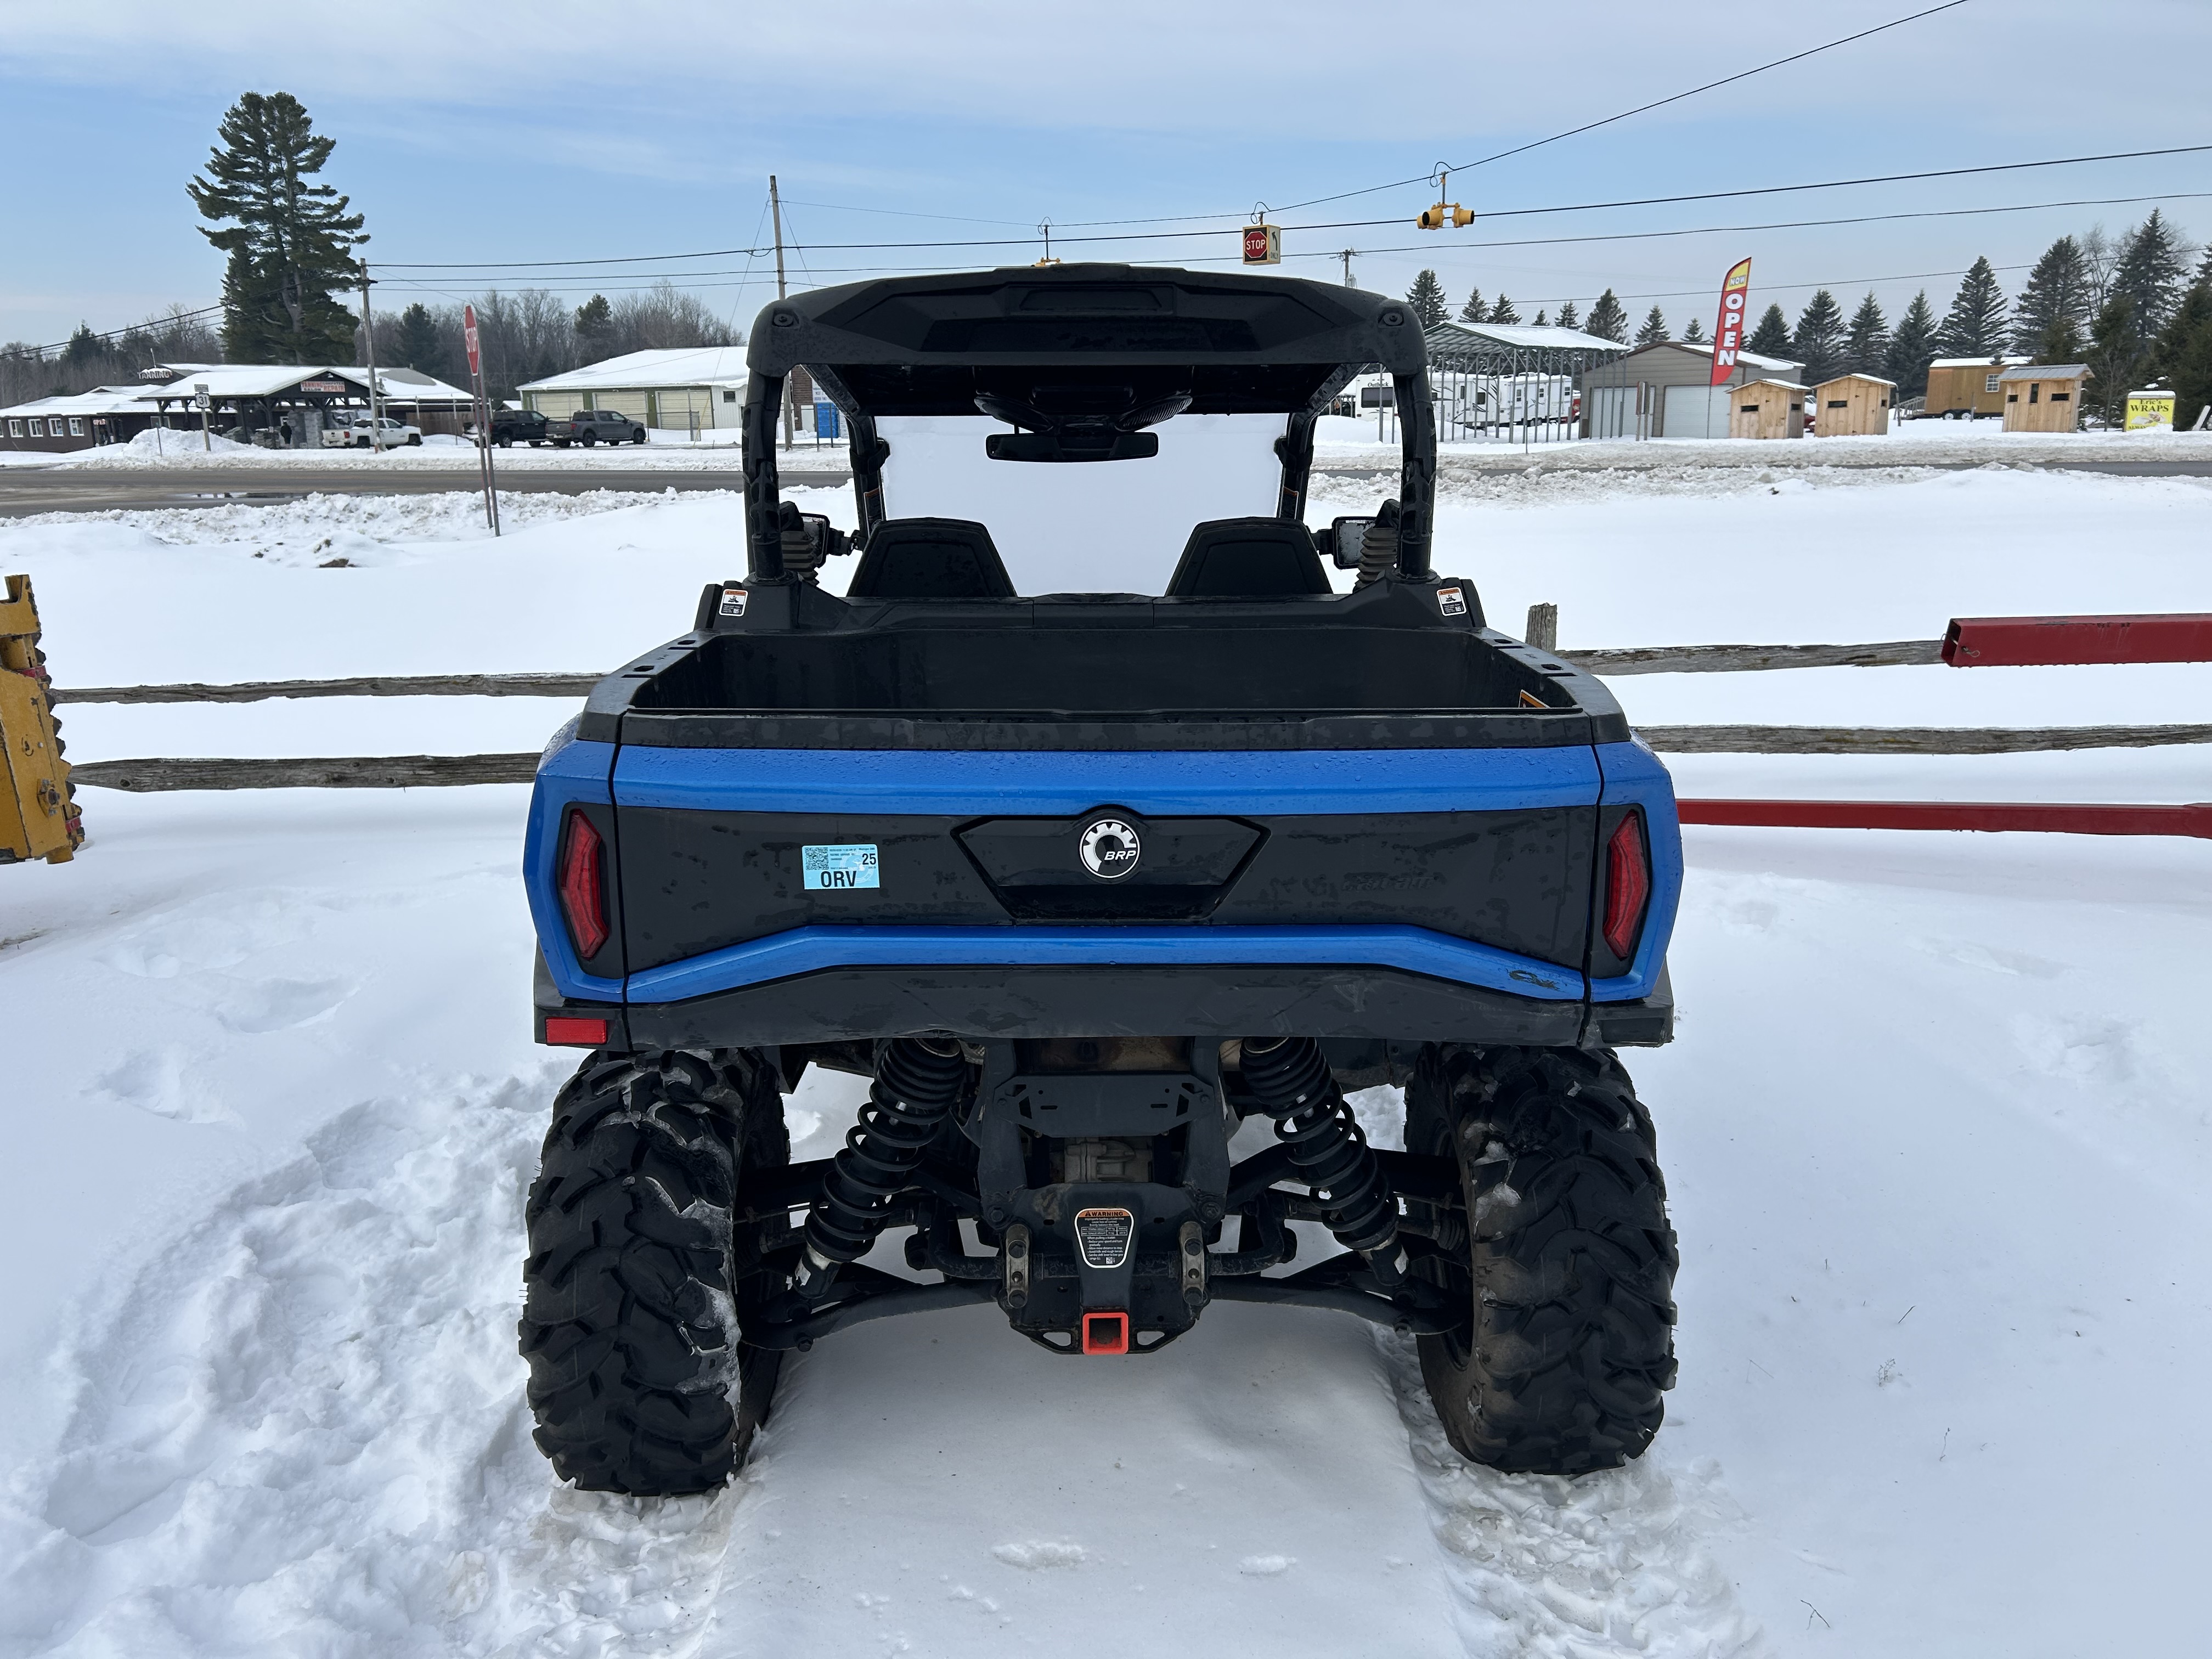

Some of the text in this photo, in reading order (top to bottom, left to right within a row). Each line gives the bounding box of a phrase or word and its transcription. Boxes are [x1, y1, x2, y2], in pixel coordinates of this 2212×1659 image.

[1246, 240, 1266, 250] STOP
[1730, 275, 1746, 286] NOW
[1718, 293, 1743, 366] OPEN
[466, 326, 477, 353] STOP
[137, 370, 170, 379] TANNING
[199, 396, 207, 405] 31
[862, 853, 876, 865] 25
[1104, 850, 1136, 860] BRP
[821, 871, 856, 888] ORV
